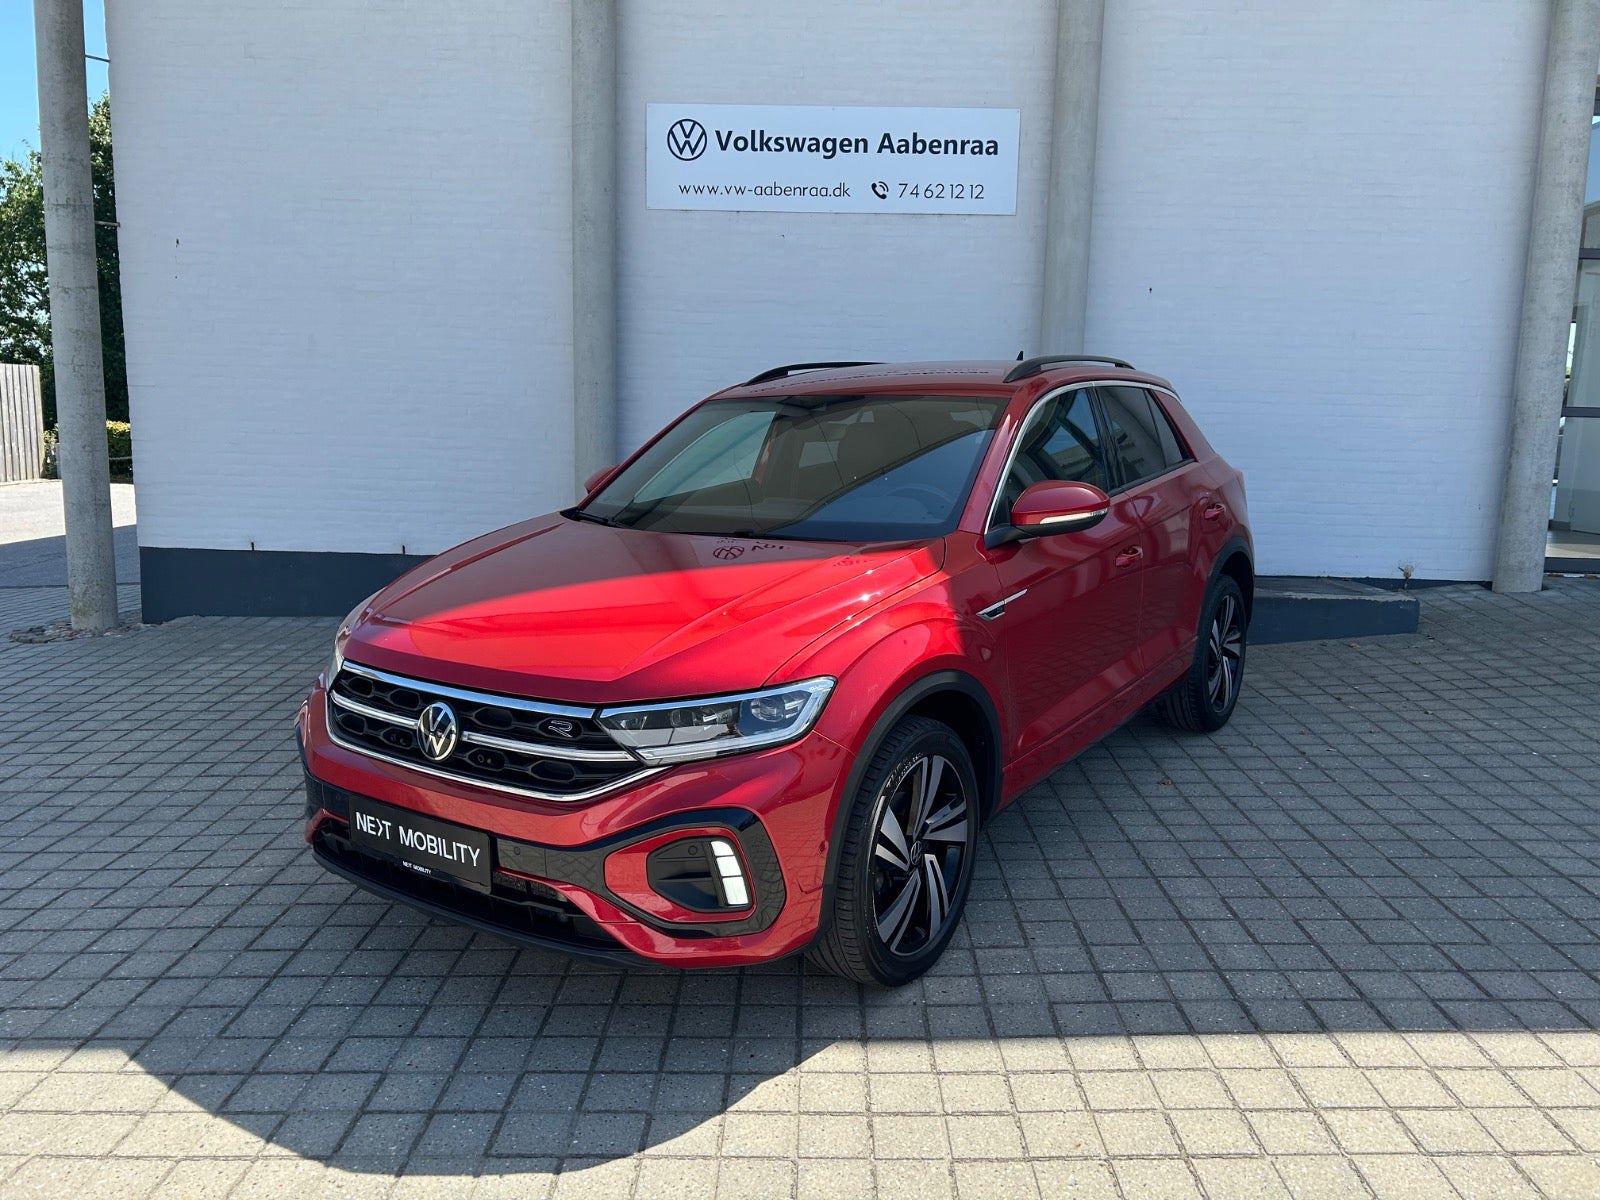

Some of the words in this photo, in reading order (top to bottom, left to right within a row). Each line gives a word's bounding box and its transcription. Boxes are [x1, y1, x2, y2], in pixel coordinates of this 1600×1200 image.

[715, 129, 868, 159] Volkswagen
[877, 132, 999, 156] Aabenraa
[678, 181, 851, 198] www.vw-aabenraa.dk
[398, 825, 481, 867] MOBILITY
